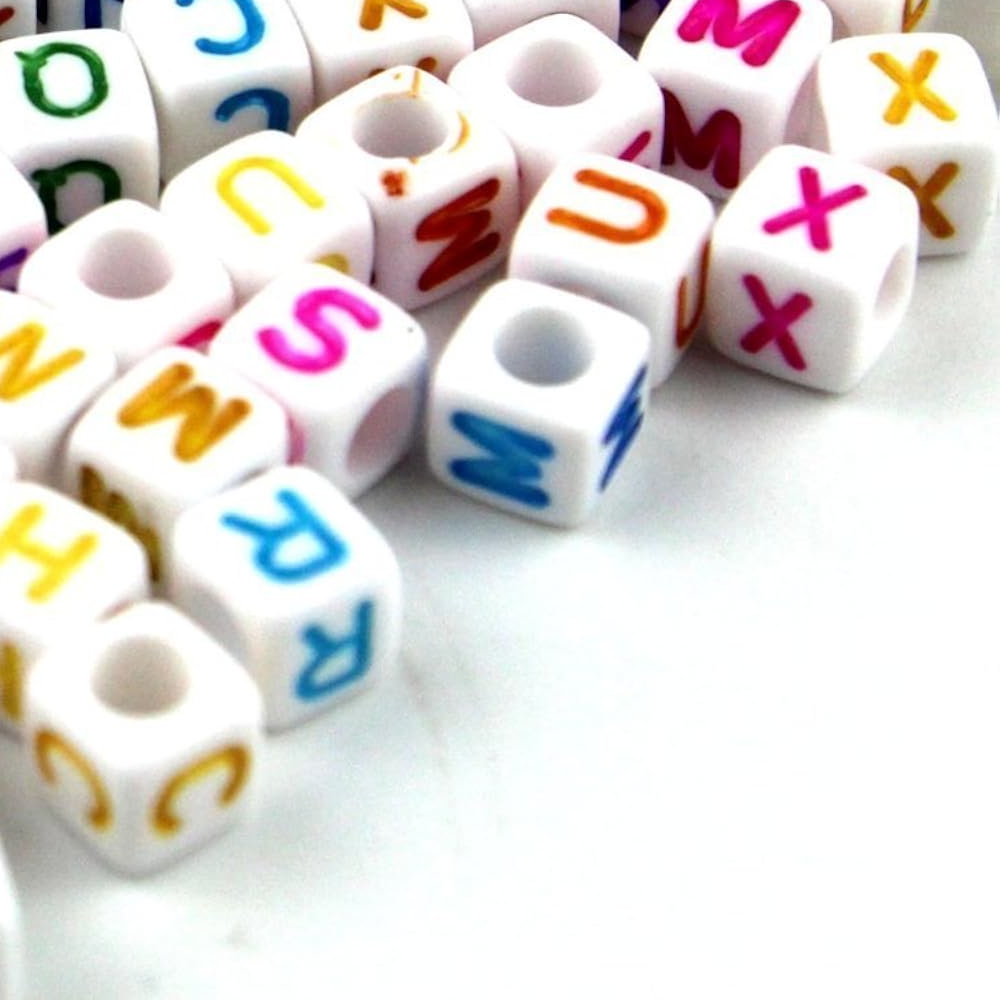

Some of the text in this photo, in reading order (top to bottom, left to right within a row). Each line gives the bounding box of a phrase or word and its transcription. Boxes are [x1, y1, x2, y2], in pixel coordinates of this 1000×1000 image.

[866, 46, 961, 129] X
[213, 153, 328, 239] U
[544, 166, 672, 248] U
[759, 163, 870, 255] X
[254, 285, 384, 378] S
[741, 275, 813, 371] X
[219, 486, 352, 587] R
[295, 600, 374, 703] R
